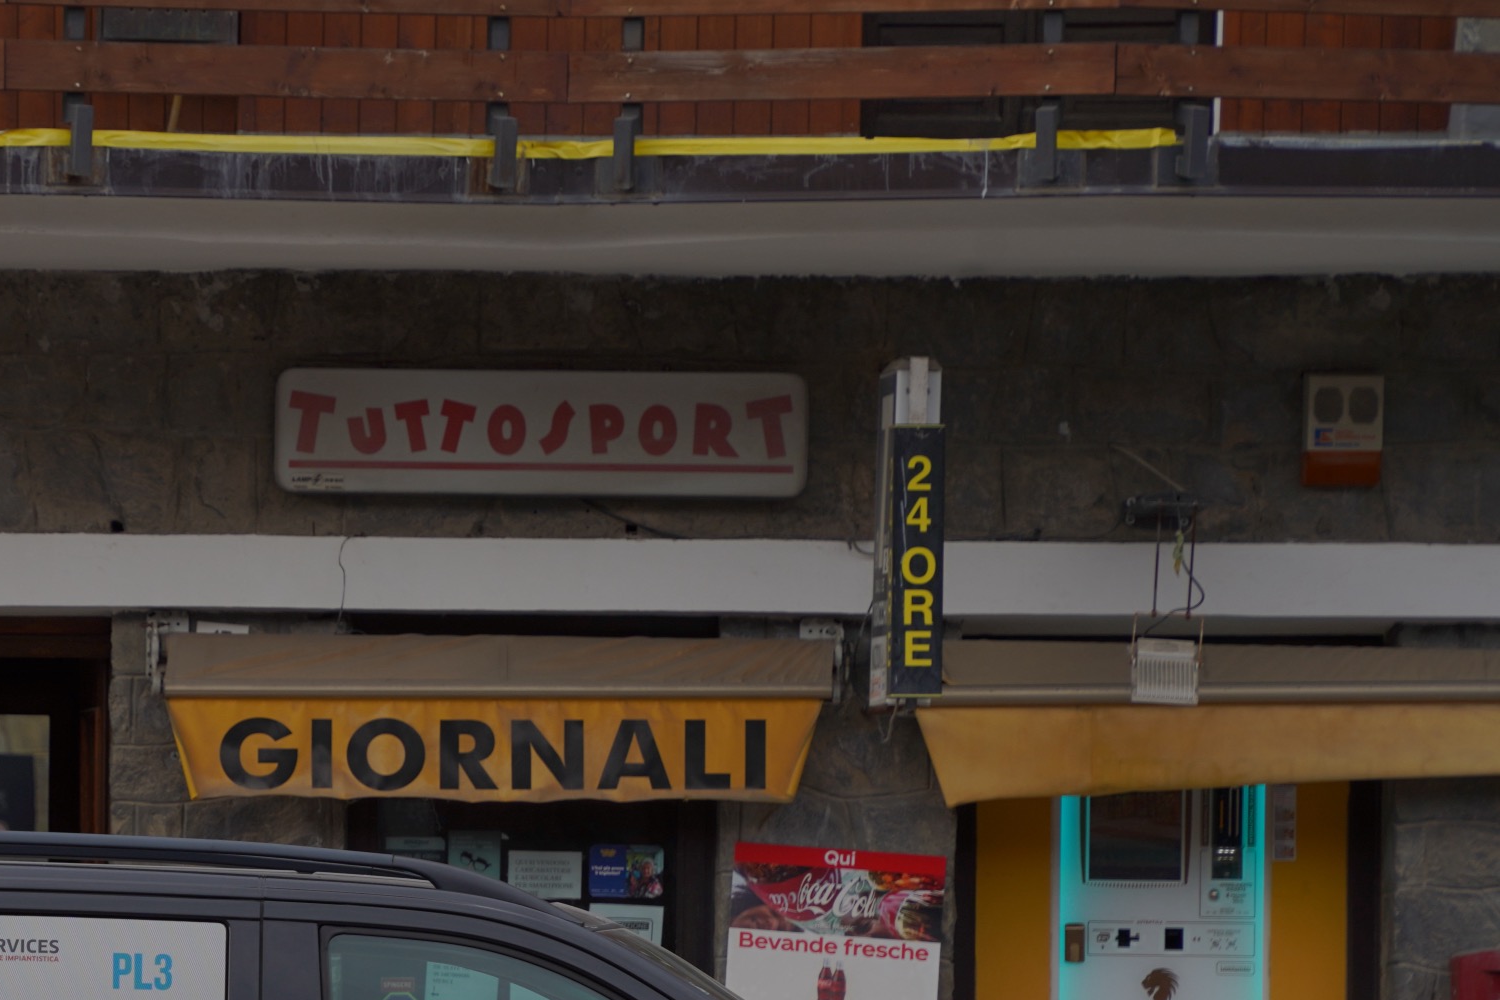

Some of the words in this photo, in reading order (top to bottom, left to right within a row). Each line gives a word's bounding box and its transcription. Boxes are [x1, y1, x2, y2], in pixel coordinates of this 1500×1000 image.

[288, 390, 793, 459] TUTTOSPORT
[901, 546, 937, 667] ORE
[220, 717, 767, 791] GIORNALI
[824, 849, 856, 867] Qui
[6, 955, 60, 963] IMPIANTISTICA
[738, 931, 838, 954] Bevande
[844, 939, 929, 961] fresche
[112, 952, 173, 991] PL3
